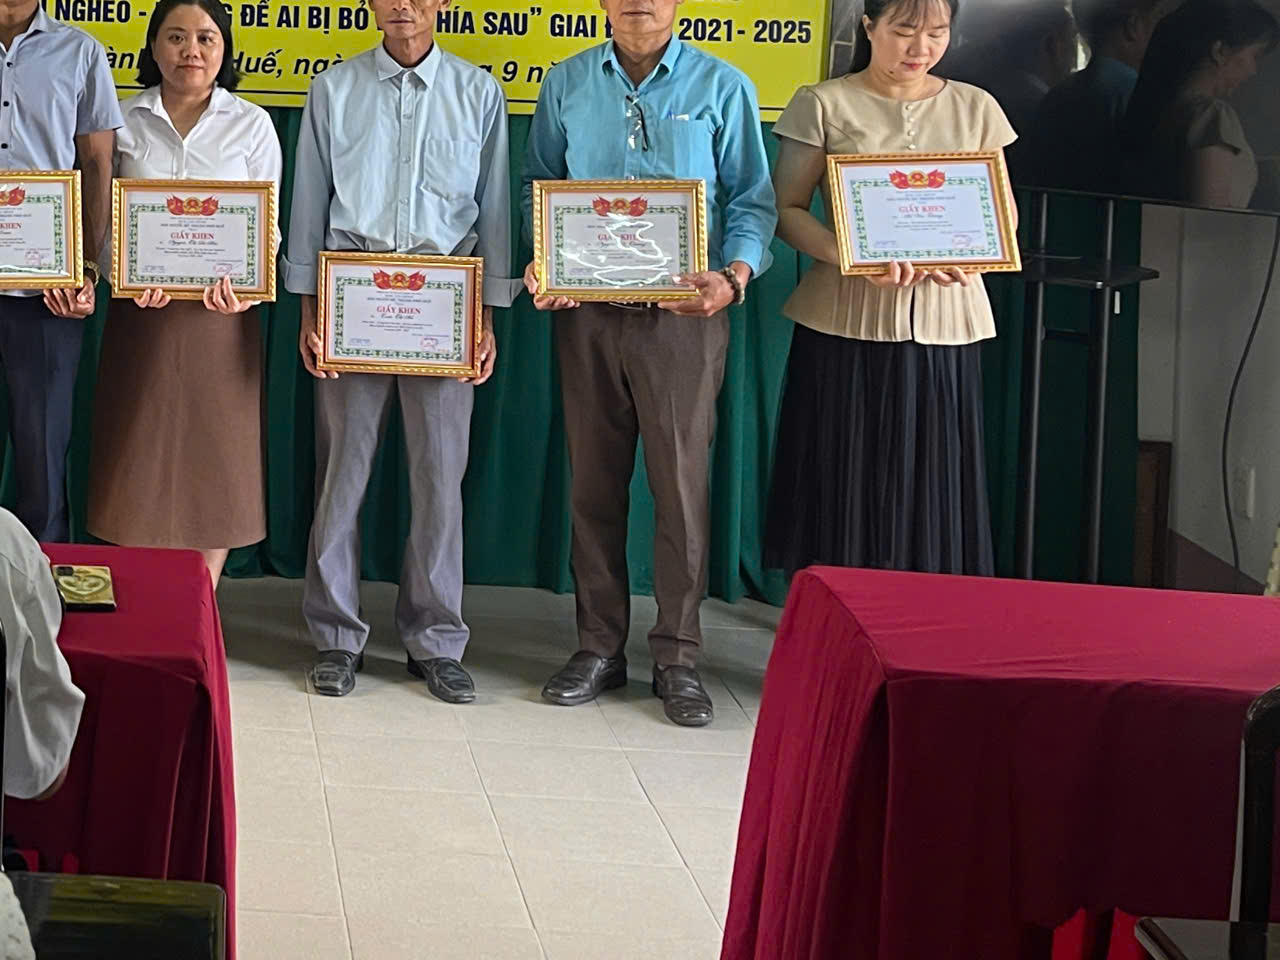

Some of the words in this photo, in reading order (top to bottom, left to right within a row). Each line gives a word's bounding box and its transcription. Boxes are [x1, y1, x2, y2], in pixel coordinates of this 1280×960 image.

[277, 6, 299, 28] AI
[308, 6, 330, 34] BỊ
[338, 0, 370, 30] BỎ
[436, 4, 475, 34] HÍA
[551, 14, 596, 37] GIAI
[754, 20, 810, 43] 2025
[502, 61, 517, 82] 9
